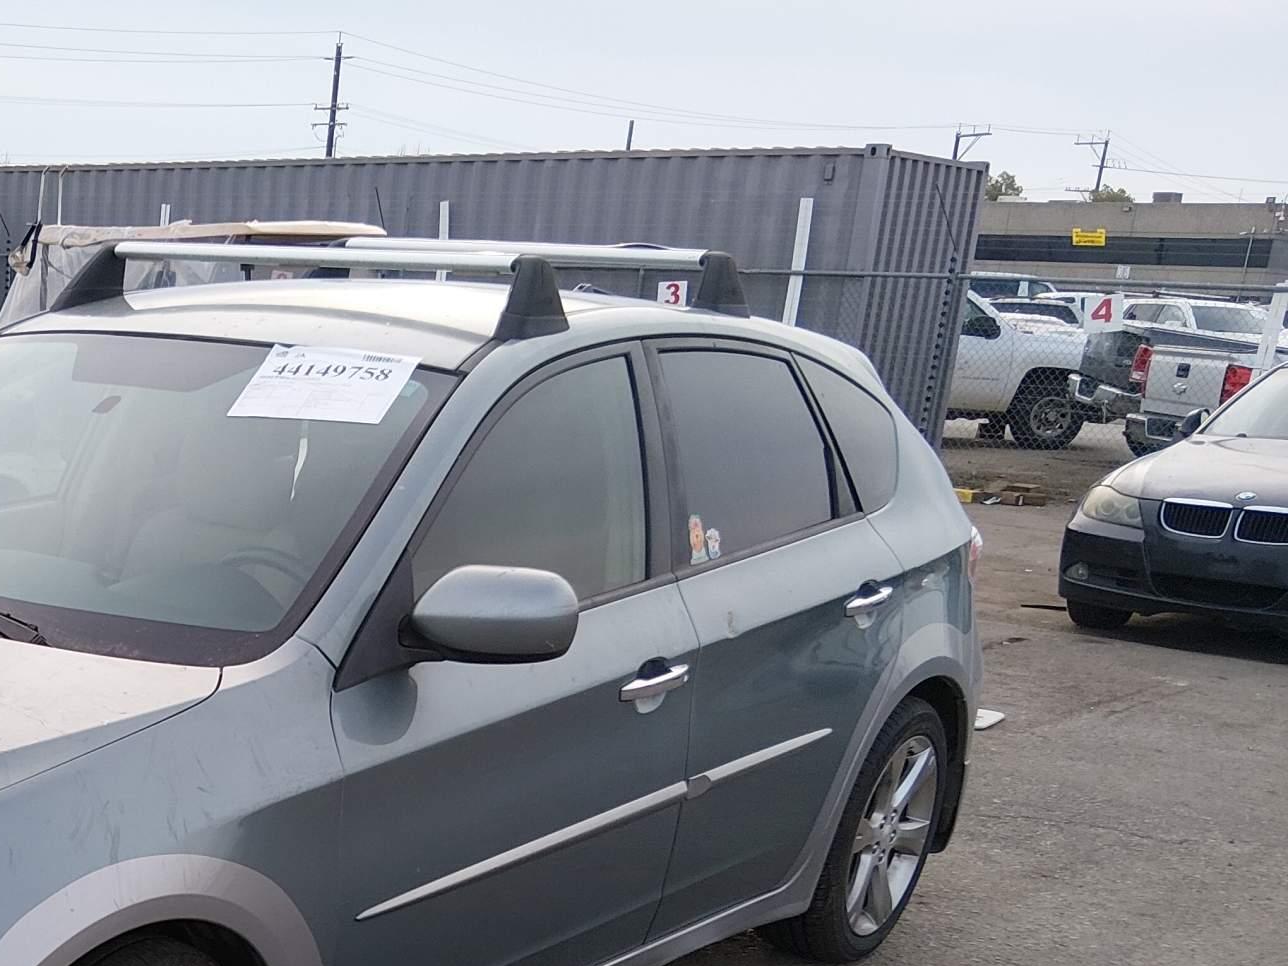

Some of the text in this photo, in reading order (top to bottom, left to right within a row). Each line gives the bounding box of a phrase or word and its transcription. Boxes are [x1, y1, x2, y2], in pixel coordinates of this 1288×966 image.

[664, 283, 680, 305] 3
[1091, 298, 1113, 323] 4
[272, 363, 393, 382] 44149758
